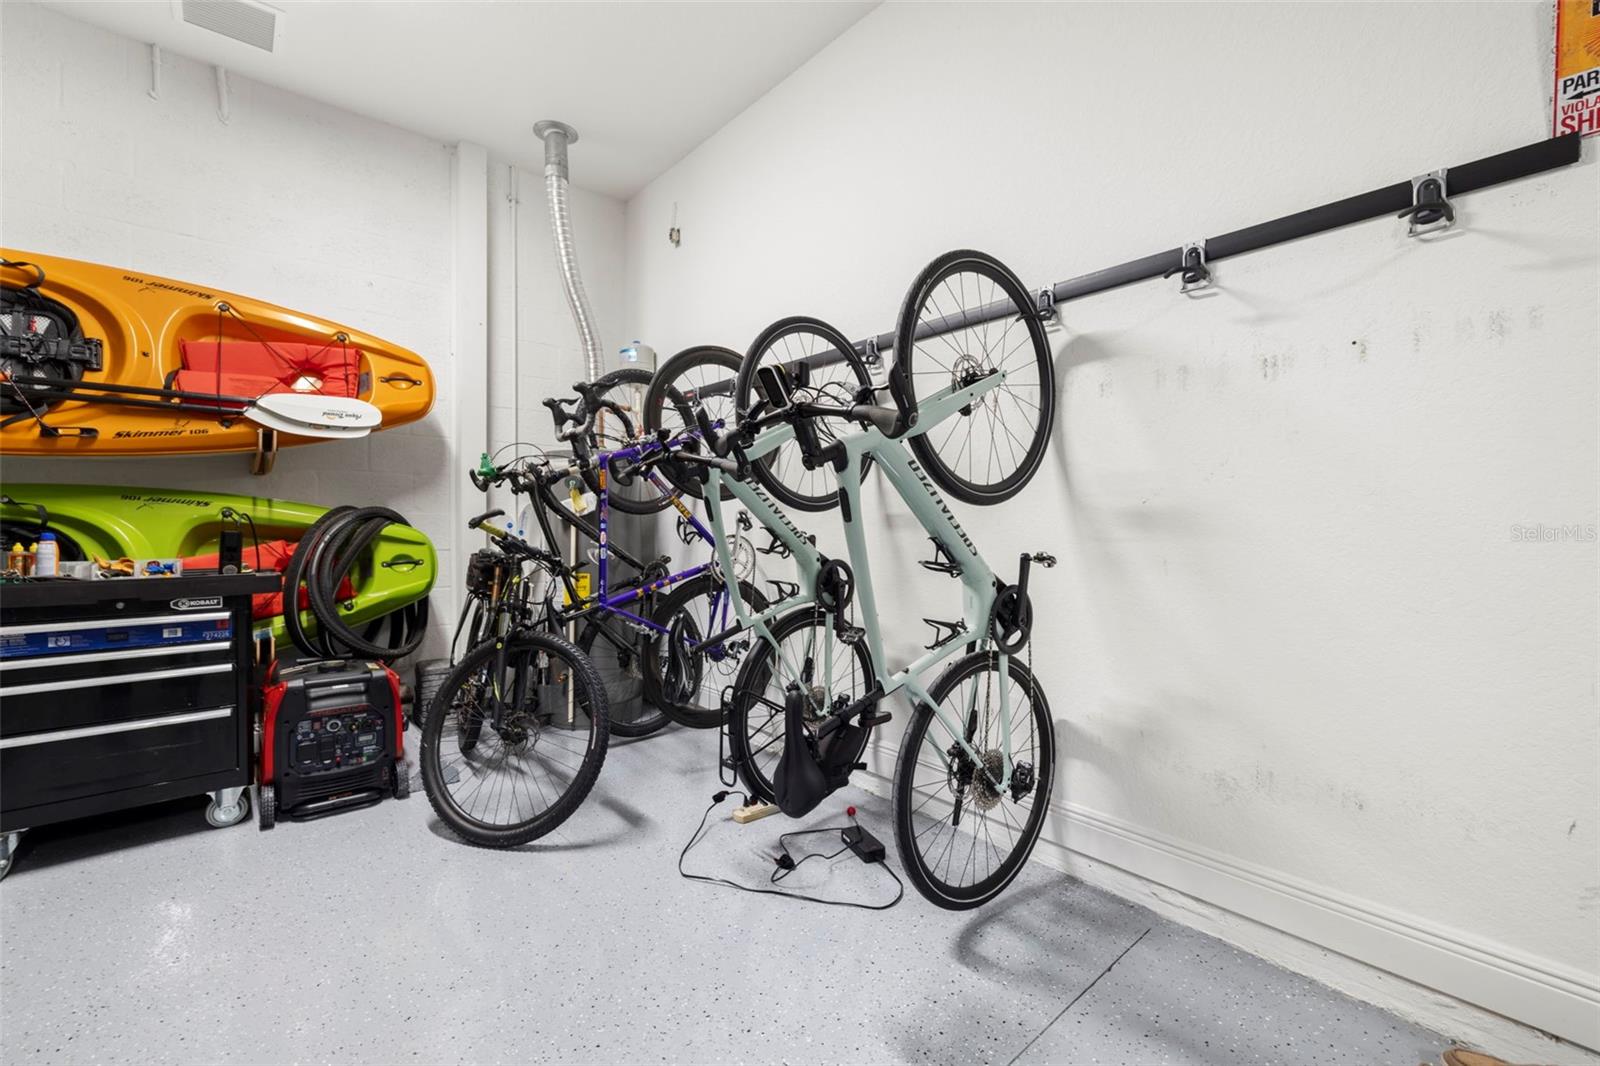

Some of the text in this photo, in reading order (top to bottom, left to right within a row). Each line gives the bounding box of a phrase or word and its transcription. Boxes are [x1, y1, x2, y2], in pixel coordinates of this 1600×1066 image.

[1563, 70, 1600, 95] PAR
[145, 281, 214, 299] Skimmer
[112, 429, 186, 440] Skimmer
